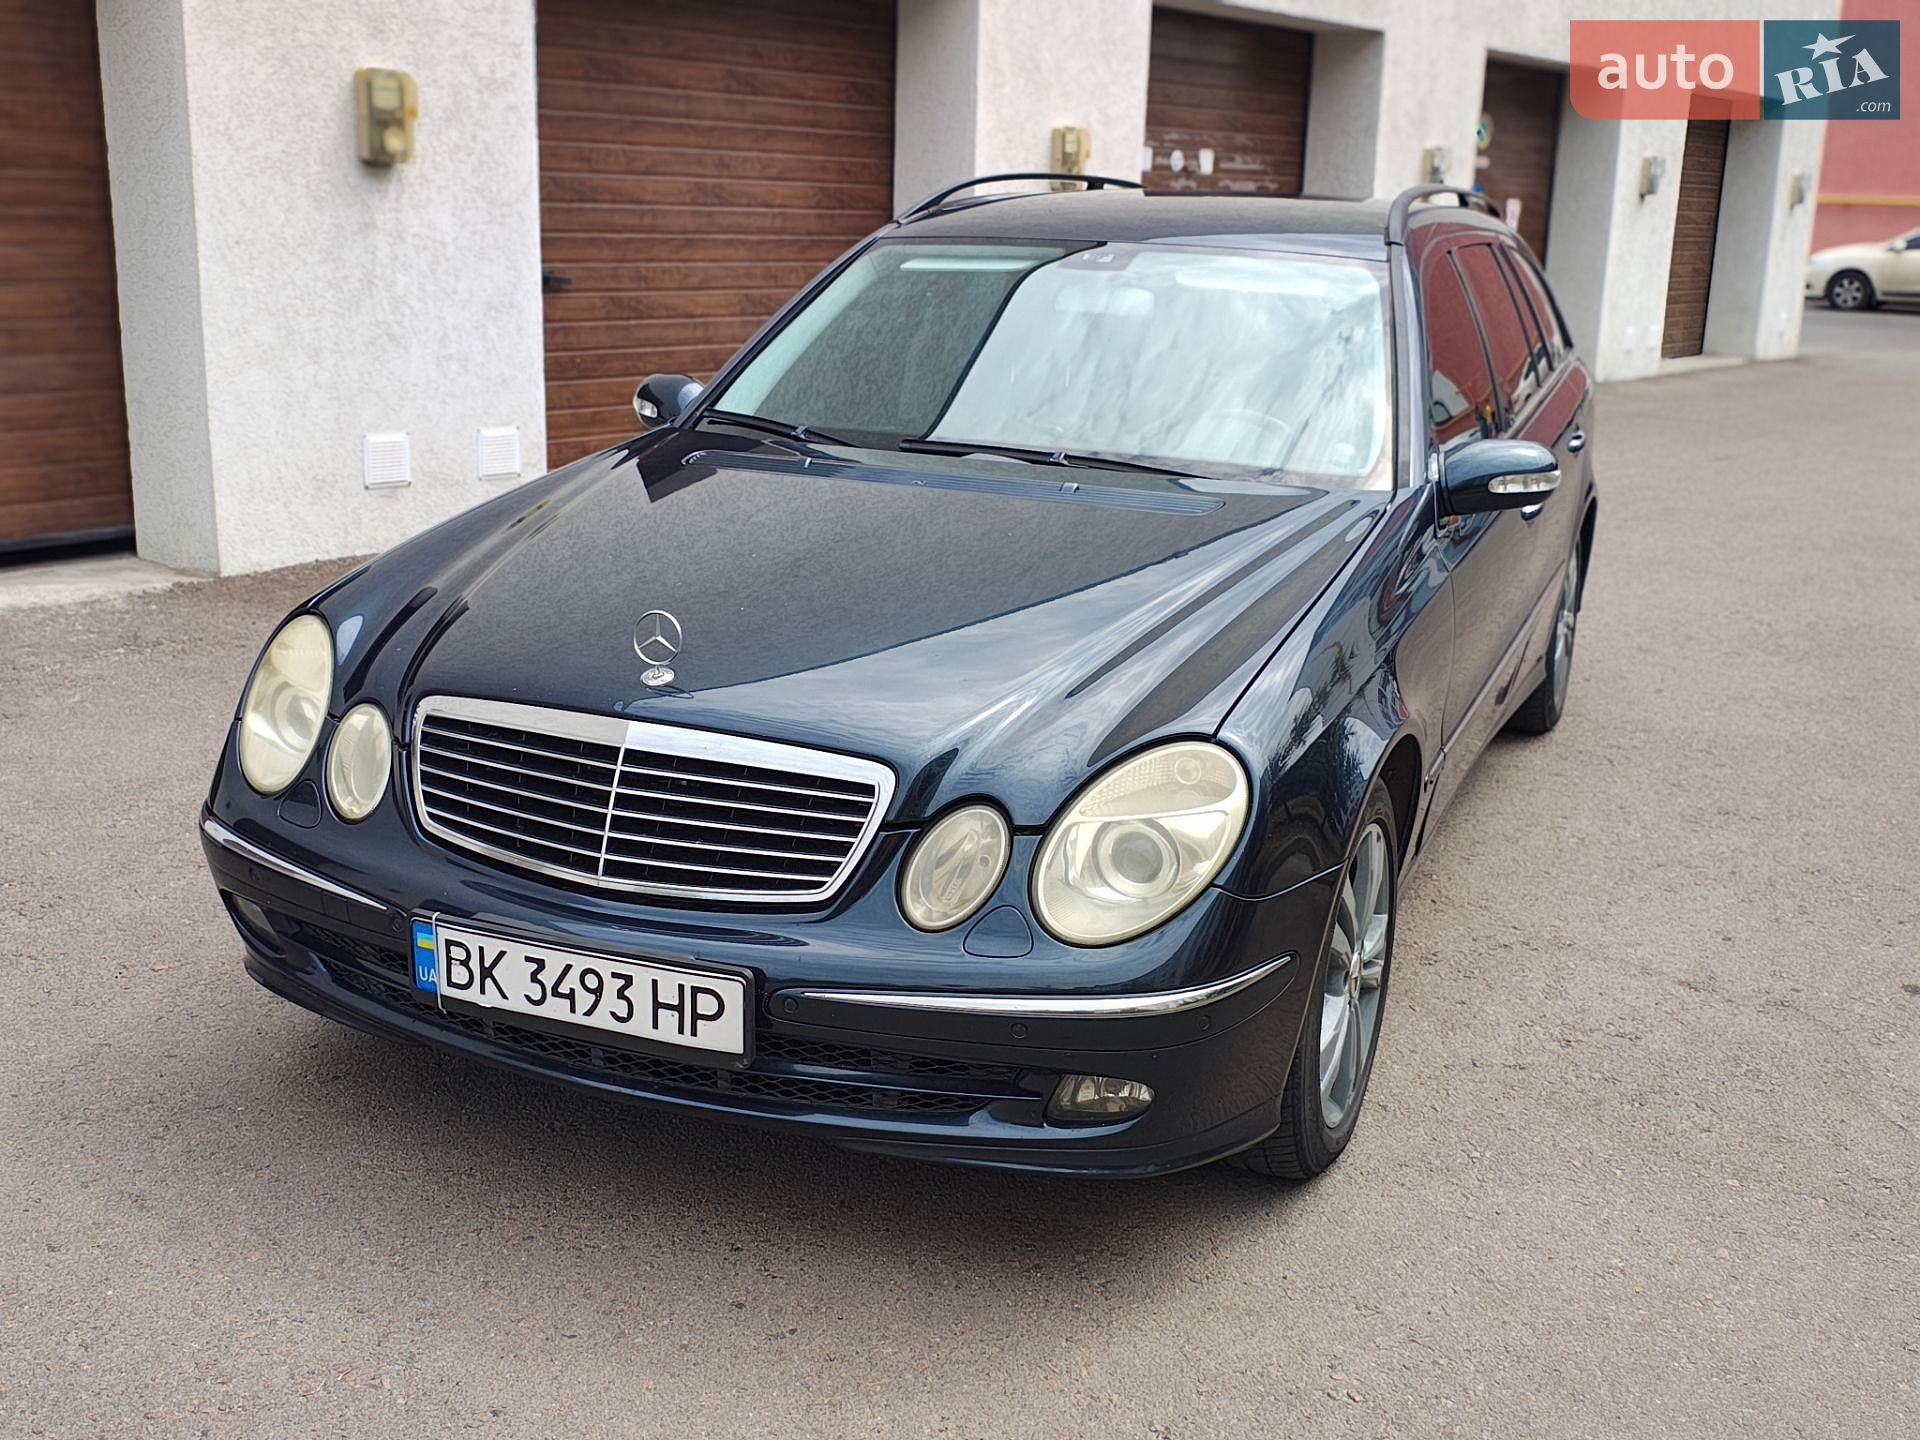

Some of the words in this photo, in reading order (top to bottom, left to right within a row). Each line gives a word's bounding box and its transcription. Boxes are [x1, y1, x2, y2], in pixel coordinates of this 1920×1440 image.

[418, 965, 438, 983] UA
[444, 938, 510, 1000] BK
[523, 955, 634, 1024] 3493
[651, 978, 726, 1037] HP
